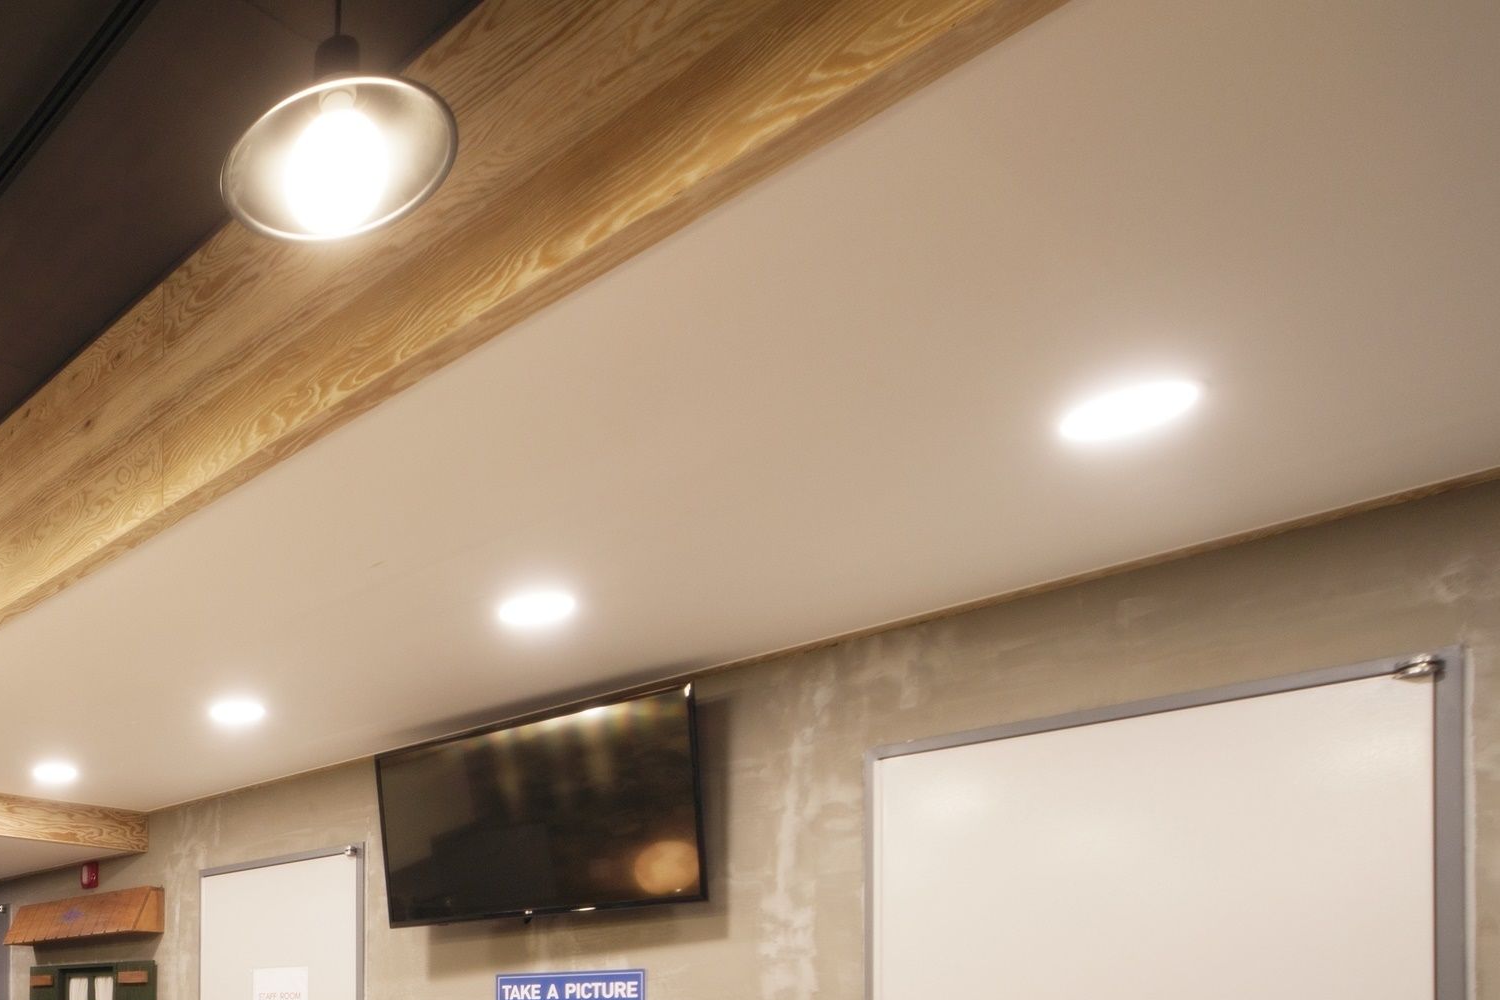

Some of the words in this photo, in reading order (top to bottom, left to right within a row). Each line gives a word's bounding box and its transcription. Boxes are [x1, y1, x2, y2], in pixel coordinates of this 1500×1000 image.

[258, 992, 278, 1000] STAFF
[279, 991, 301, 1000] ROOM
[501, 983, 542, 1000] TAKE
[546, 983, 560, 1000] A
[564, 980, 639, 1000] PICTURE
